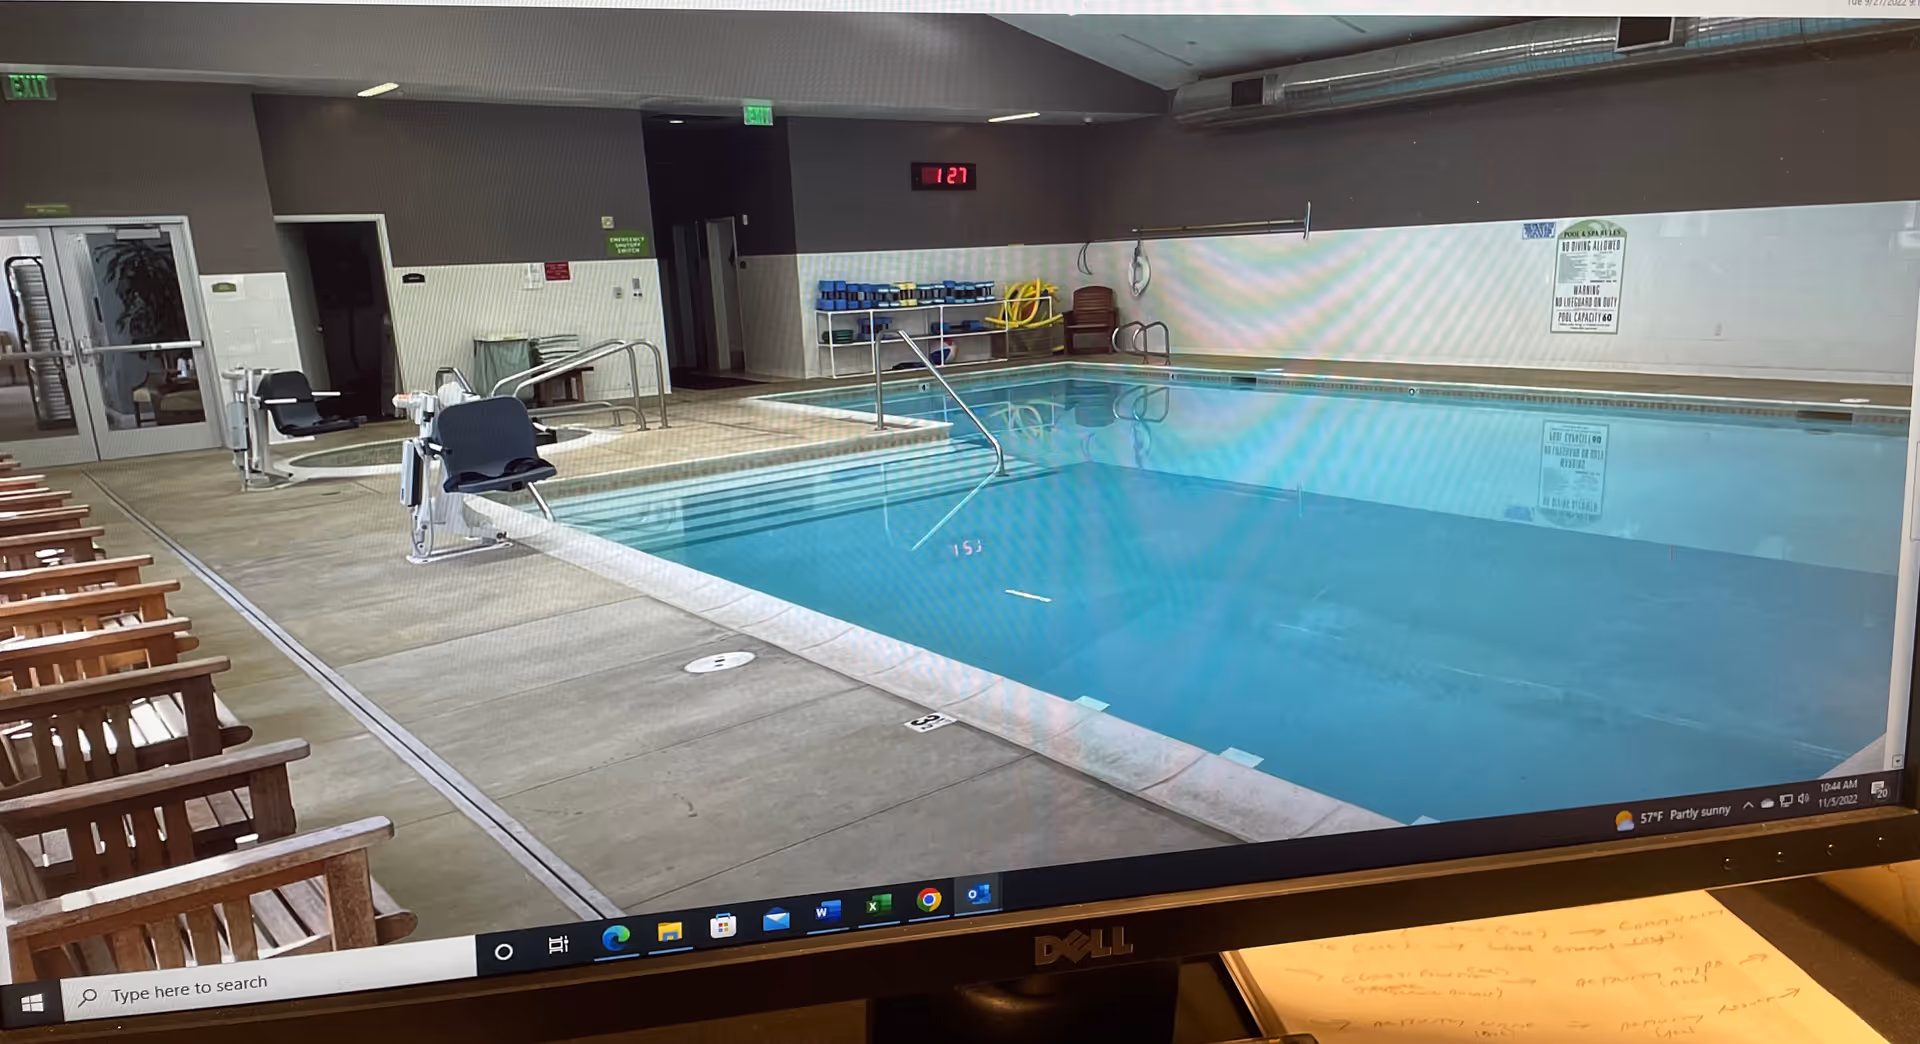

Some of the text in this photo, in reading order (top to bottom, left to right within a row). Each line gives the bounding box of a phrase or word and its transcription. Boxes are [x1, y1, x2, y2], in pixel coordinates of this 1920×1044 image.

[1562, 240, 1620, 251] NO DIVING ALLOWED
[1573, 285, 1600, 295] WARNING
[1555, 297, 1617, 308] NO LIFEGUARD ON DUTY
[1558, 312, 1612, 323] POOL CAPACITY 60
[1821, 779, 1858, 793] 10:44 AM
[1877, 788, 1888, 799] 20
[1819, 793, 1858, 809] 11/5/2022
[1640, 804, 1731, 824] 57°F Partly sunny
[1034, 926, 1134, 966] DELL
[111, 975, 268, 1005] Type here to search
